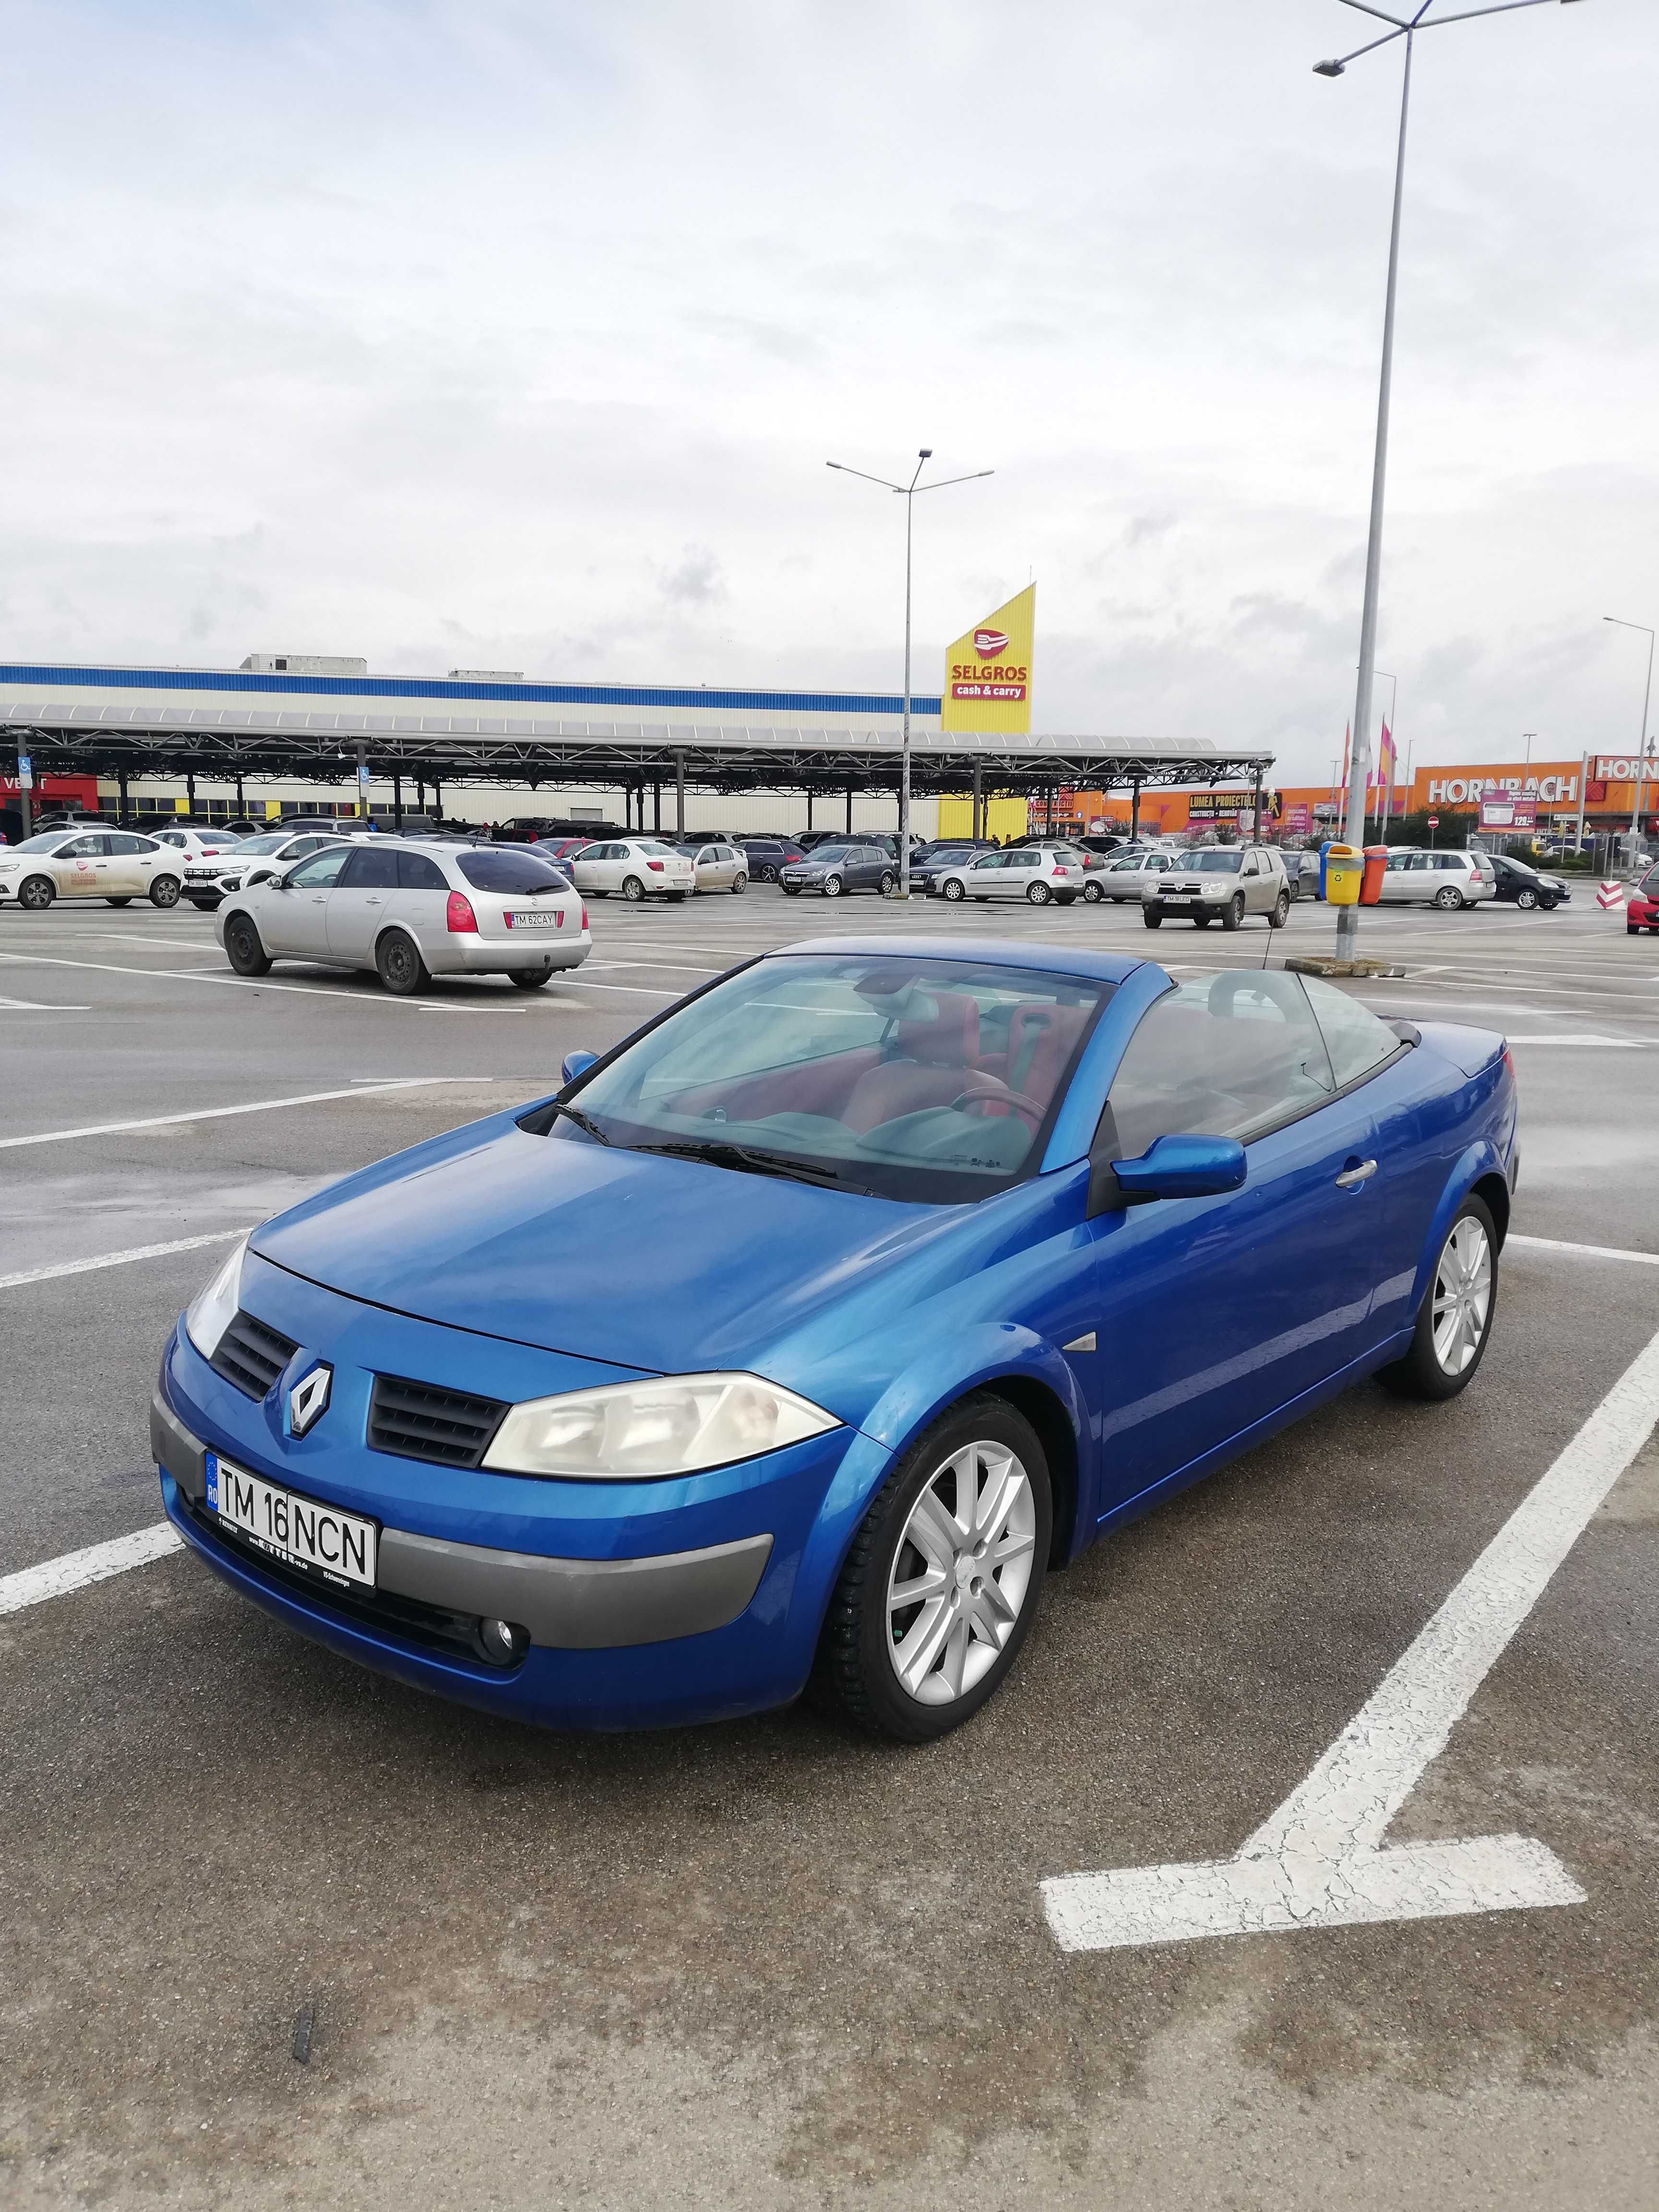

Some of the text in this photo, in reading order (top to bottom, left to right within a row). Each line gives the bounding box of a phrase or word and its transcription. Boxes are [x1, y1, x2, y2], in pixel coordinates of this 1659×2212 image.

[952, 664, 1027, 681] SELGROS
[957, 685, 1022, 698] cash & carry
[1190, 796, 1213, 807] LUMEA
[515, 915, 552, 925] TM 62CAY
[208, 1484, 217, 1504] RO
[221, 1467, 254, 1527] TM
